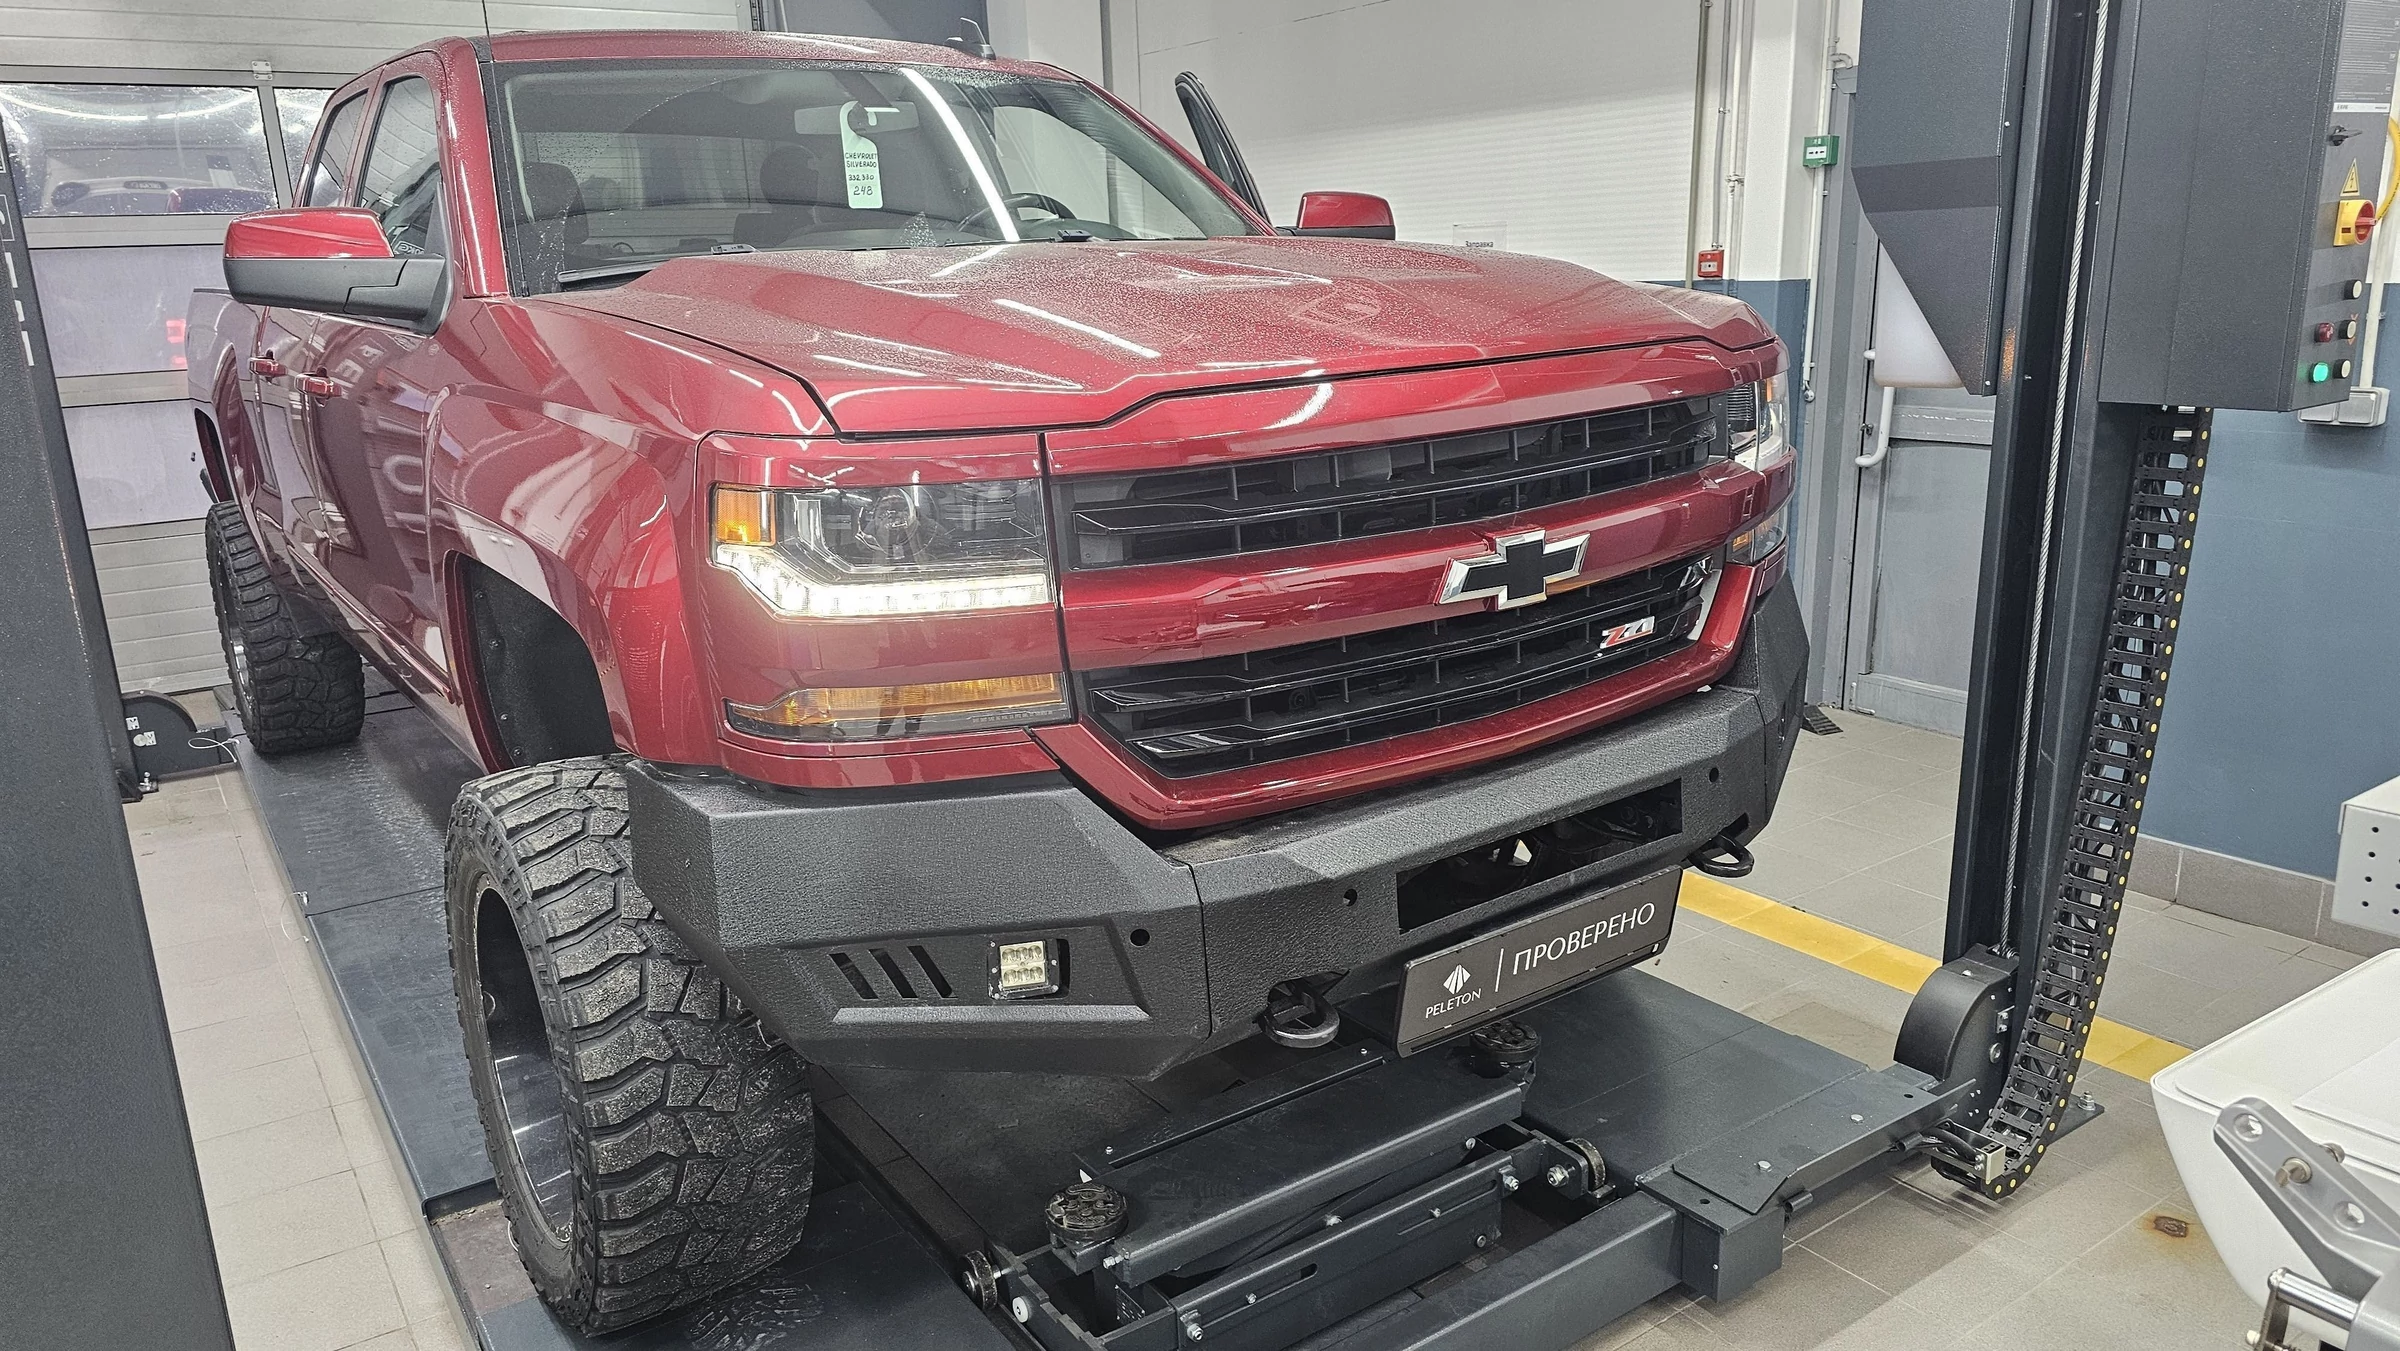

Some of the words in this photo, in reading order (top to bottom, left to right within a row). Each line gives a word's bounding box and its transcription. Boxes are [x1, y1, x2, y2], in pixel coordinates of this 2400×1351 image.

[844, 152, 878, 160] CHEVROLET
[853, 185, 873, 196] 248
[1600, 616, 1655, 649] Z71
[1513, 902, 1655, 976] ПРОВЕРЕНО
[1425, 988, 1482, 1019] PELETON
